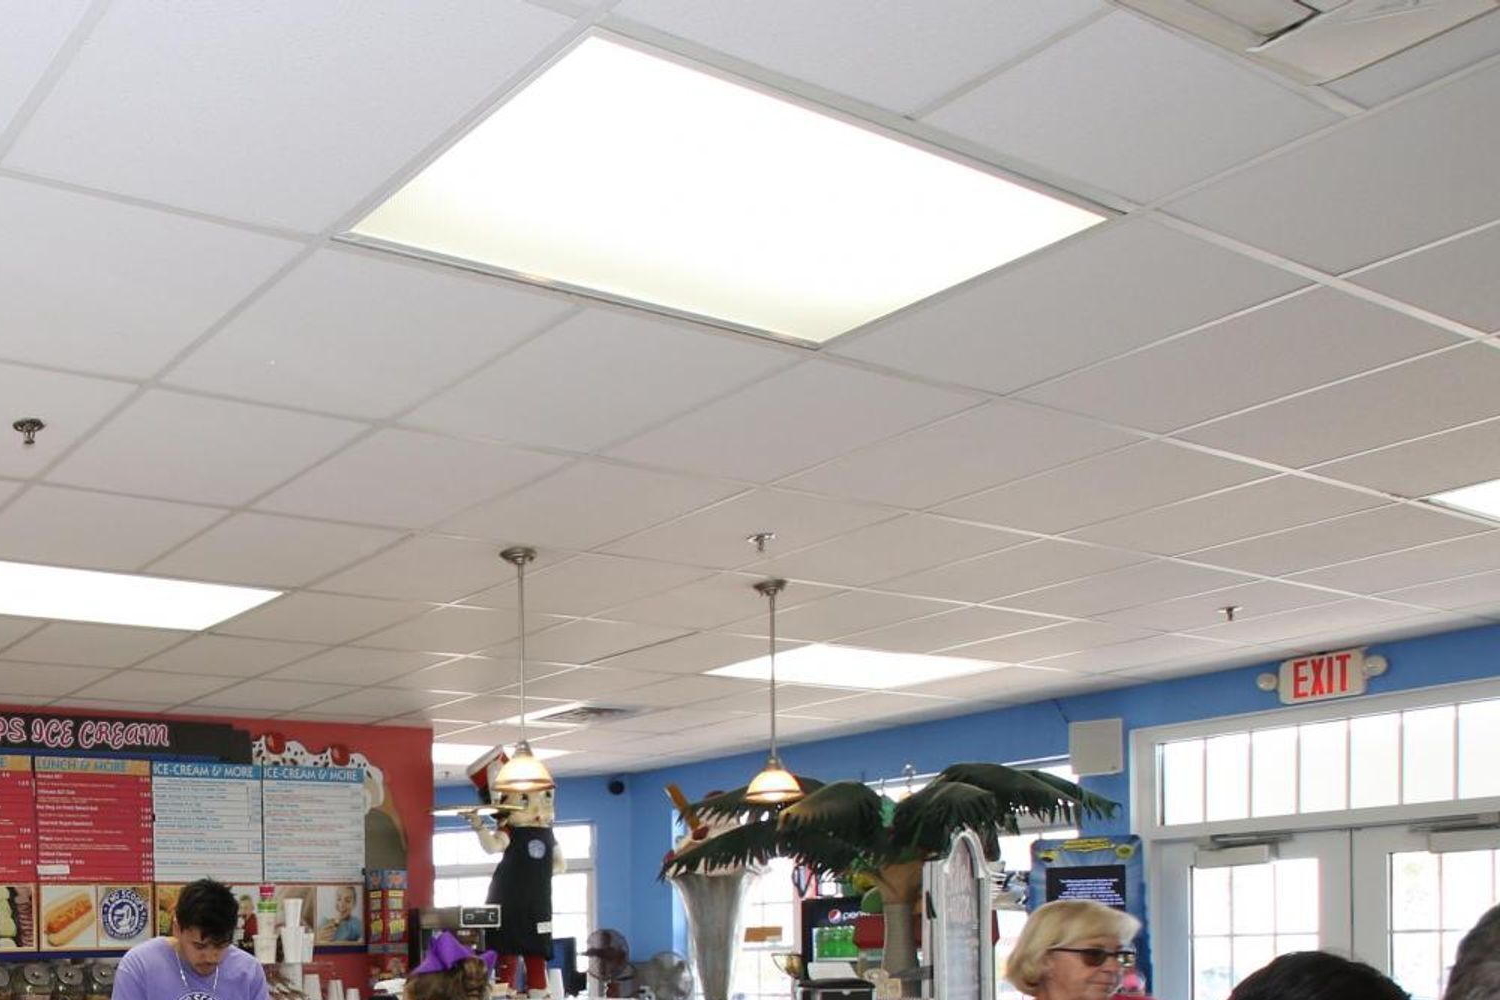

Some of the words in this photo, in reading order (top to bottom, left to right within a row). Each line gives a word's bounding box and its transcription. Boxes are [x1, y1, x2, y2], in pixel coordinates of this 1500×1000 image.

[1293, 654, 1351, 699] EXIT
[31, 717, 74, 748] ICE
[37, 758, 77, 770] LUNCH
[81, 760, 91, 771] &
[94, 761, 127, 772] MORE
[153, 763, 209, 776] ICE-CREAM
[212, 765, 220, 776] &
[225, 766, 253, 778] MORE
[263, 767, 316, 780] ICE-CREAM
[330, 769, 357, 781] MORE
